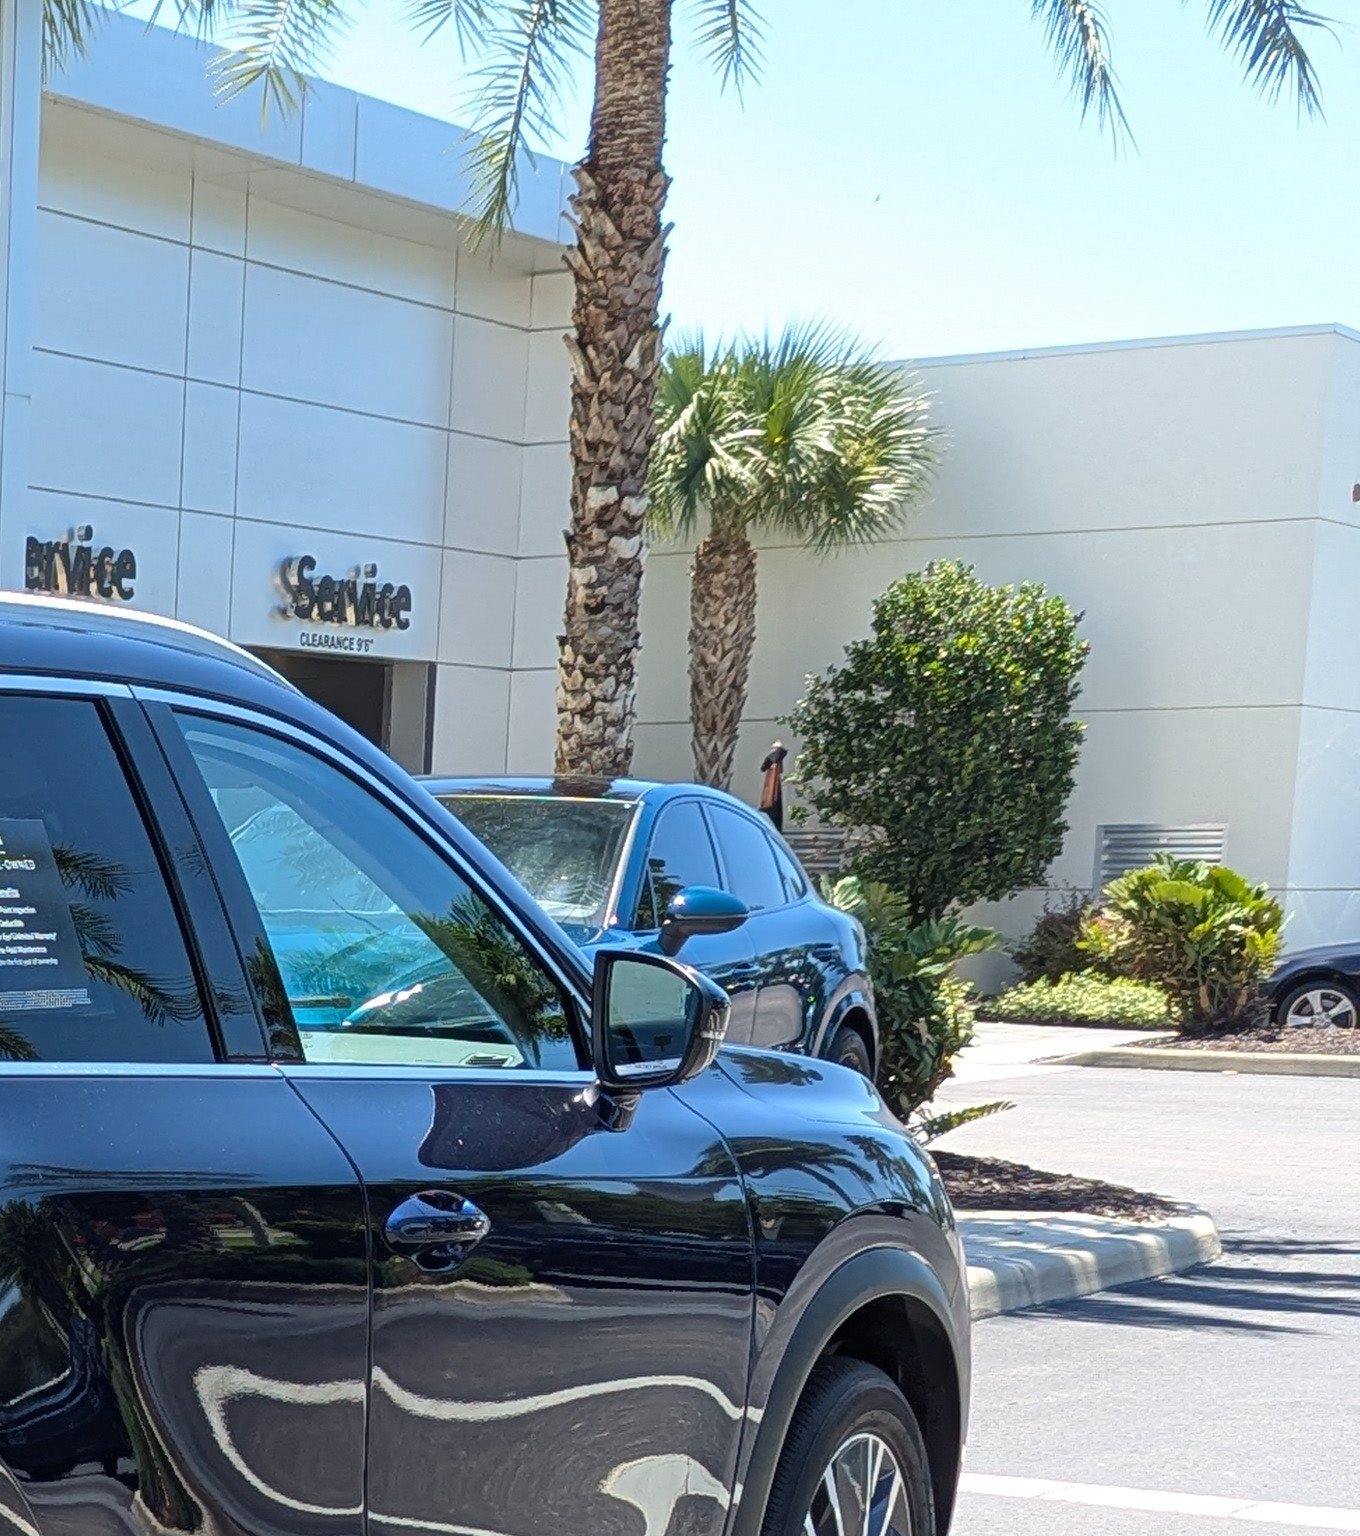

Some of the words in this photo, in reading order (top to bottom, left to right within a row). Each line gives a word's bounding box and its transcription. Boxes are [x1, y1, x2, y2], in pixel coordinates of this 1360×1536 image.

[25, 524, 137, 601] ervice
[281, 554, 412, 630] Service
[299, 632, 354, 651] CLEARANCE
